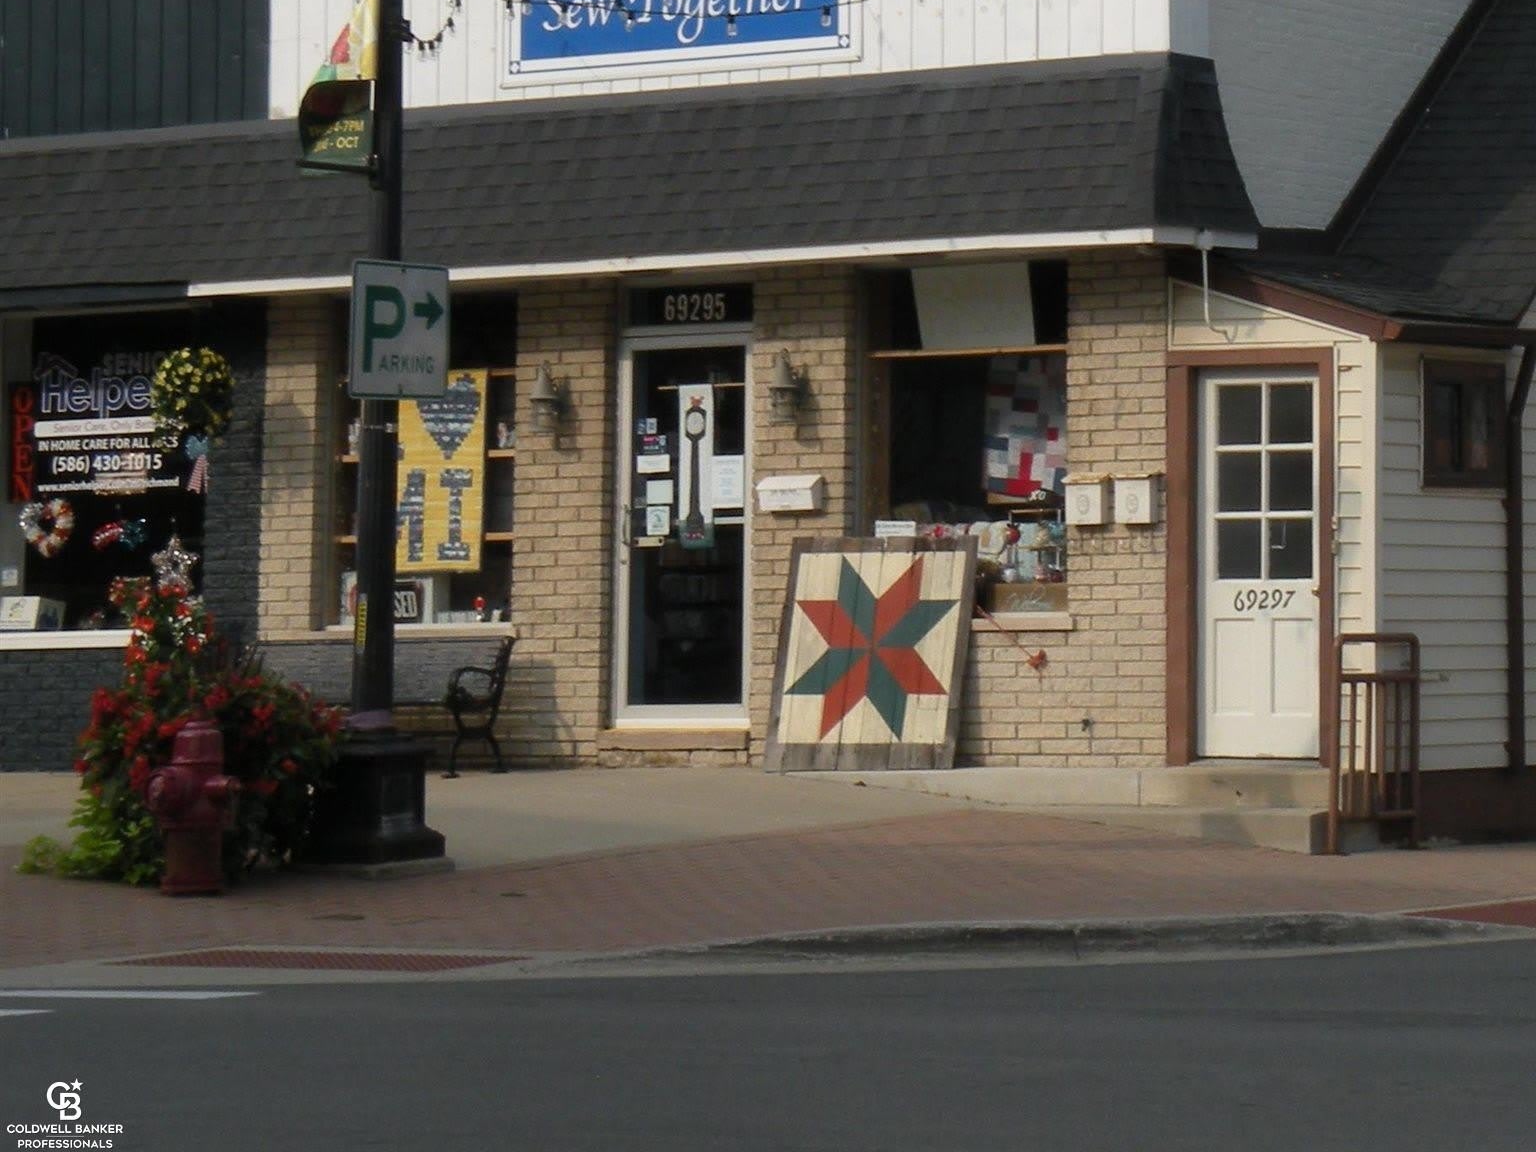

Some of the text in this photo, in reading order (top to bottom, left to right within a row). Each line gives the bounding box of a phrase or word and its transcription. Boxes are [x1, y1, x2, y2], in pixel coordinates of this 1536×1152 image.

[664, 293, 727, 322] 69295
[13, 388, 34, 502] OPEN
[38, 440, 50, 452] IN
[51, 438, 81, 451] HOME
[82, 437, 109, 450] CARE
[110, 437, 131, 450] FOR
[132, 436, 151, 449] ALL
[52, 452, 163, 475] (586) 430-1015
[1233, 588, 1296, 612] 69297
